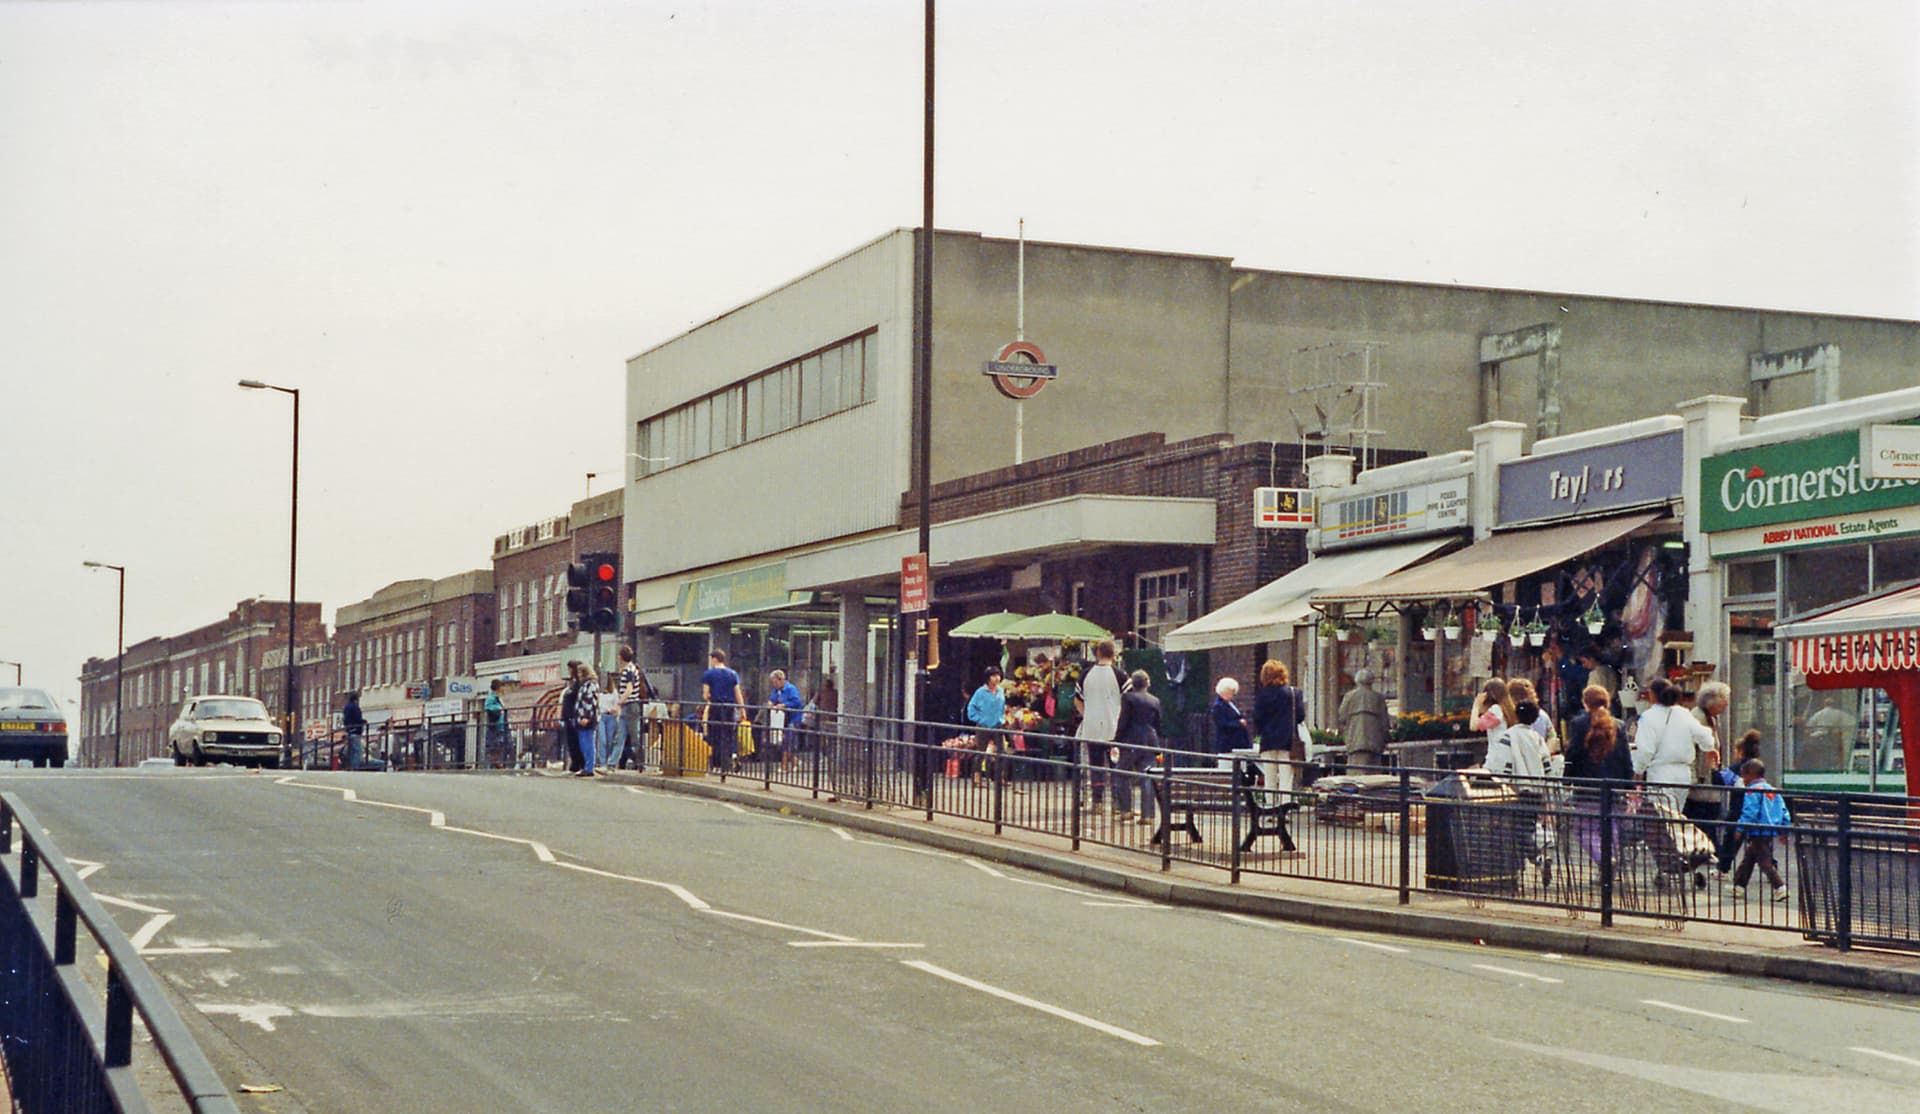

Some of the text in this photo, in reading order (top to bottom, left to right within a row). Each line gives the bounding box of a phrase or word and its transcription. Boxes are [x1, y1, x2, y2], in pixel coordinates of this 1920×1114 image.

[1550, 465, 1624, 504] Taylrs
[1721, 456, 1920, 512] Cornersto
[1763, 518, 1898, 544] ABBEY NATIONAL Estate Agents
[1820, 642, 1847, 660] THE
[449, 681, 473, 694] Gas
